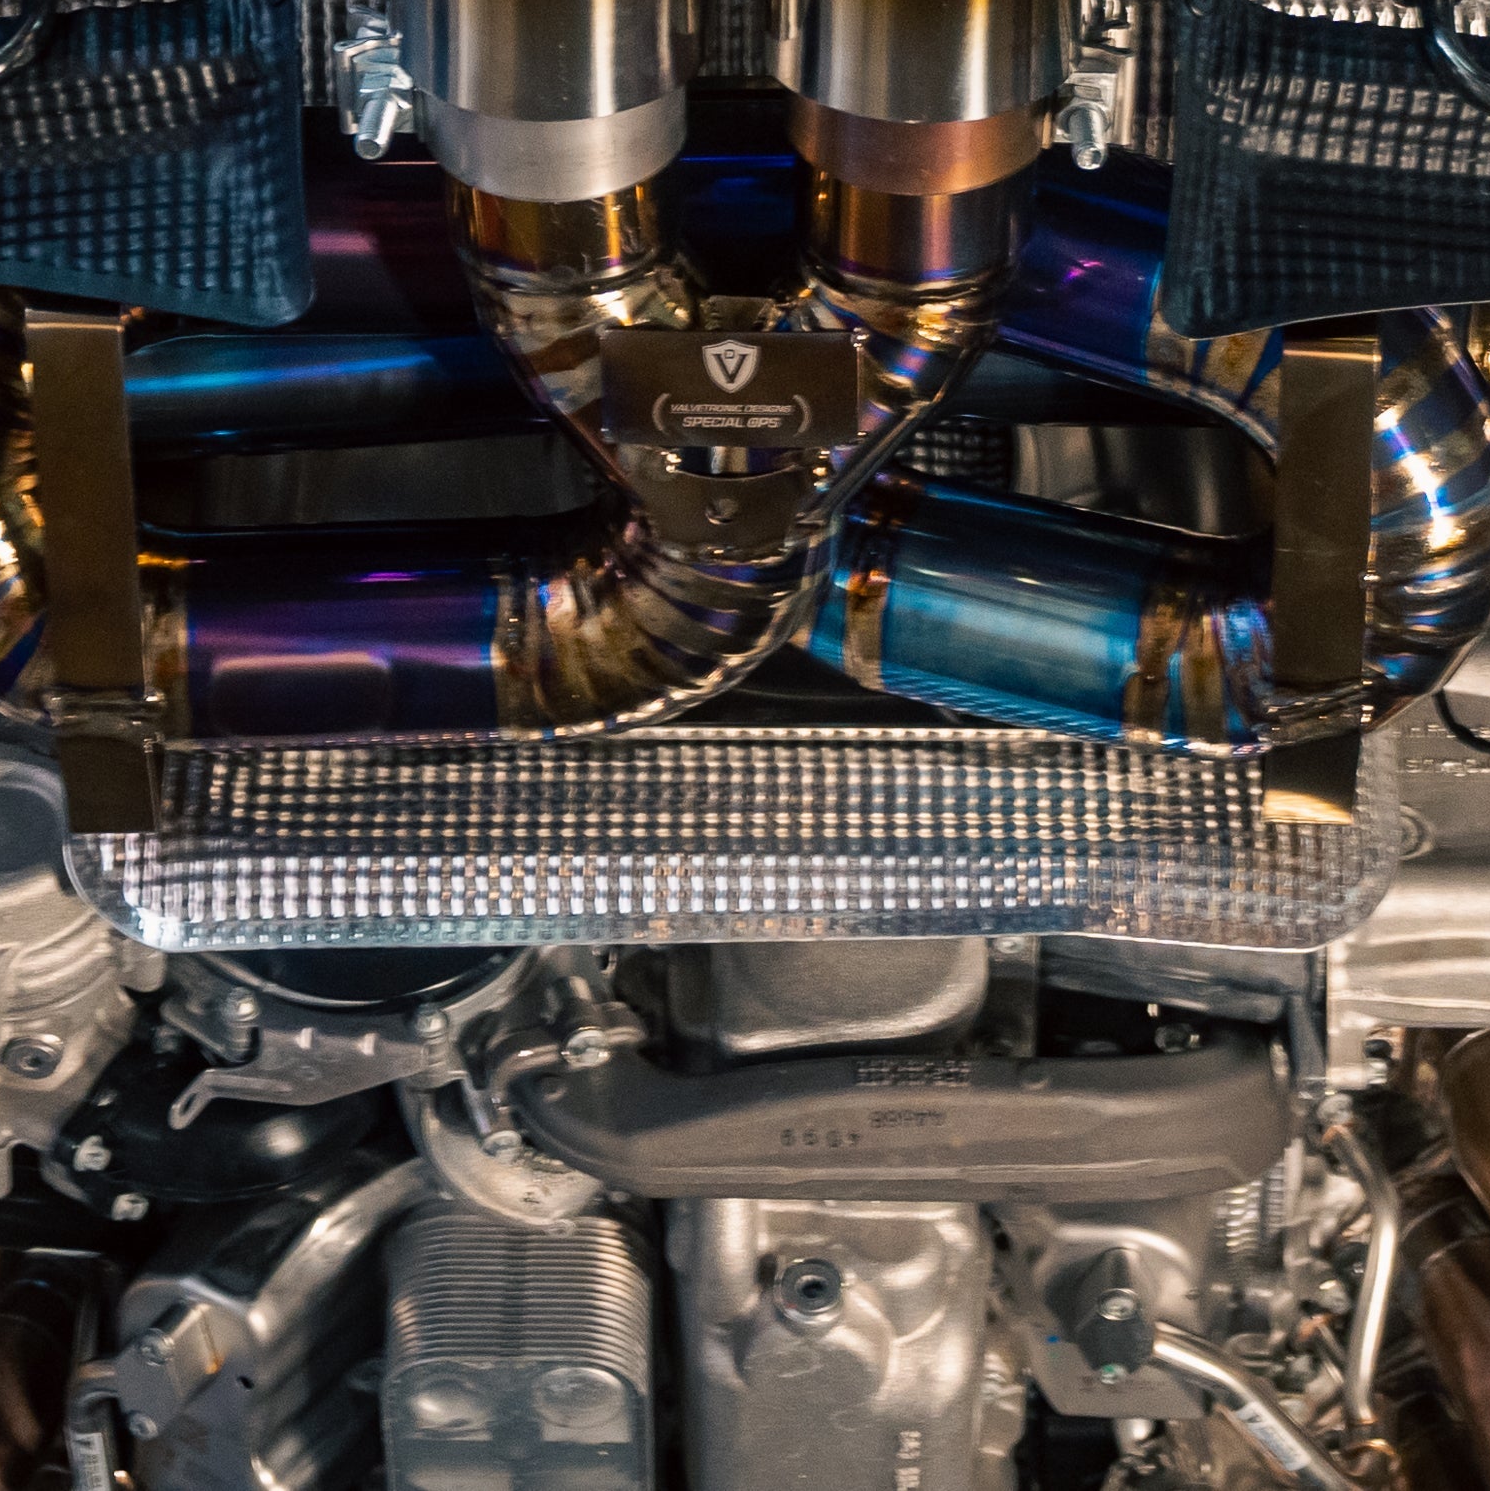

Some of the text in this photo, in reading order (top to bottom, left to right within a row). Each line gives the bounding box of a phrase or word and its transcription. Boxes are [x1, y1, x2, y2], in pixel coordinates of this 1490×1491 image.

[670, 403, 792, 413] VALVETRONIC DESIGNS
[682, 416, 744, 429] SPECIAL
